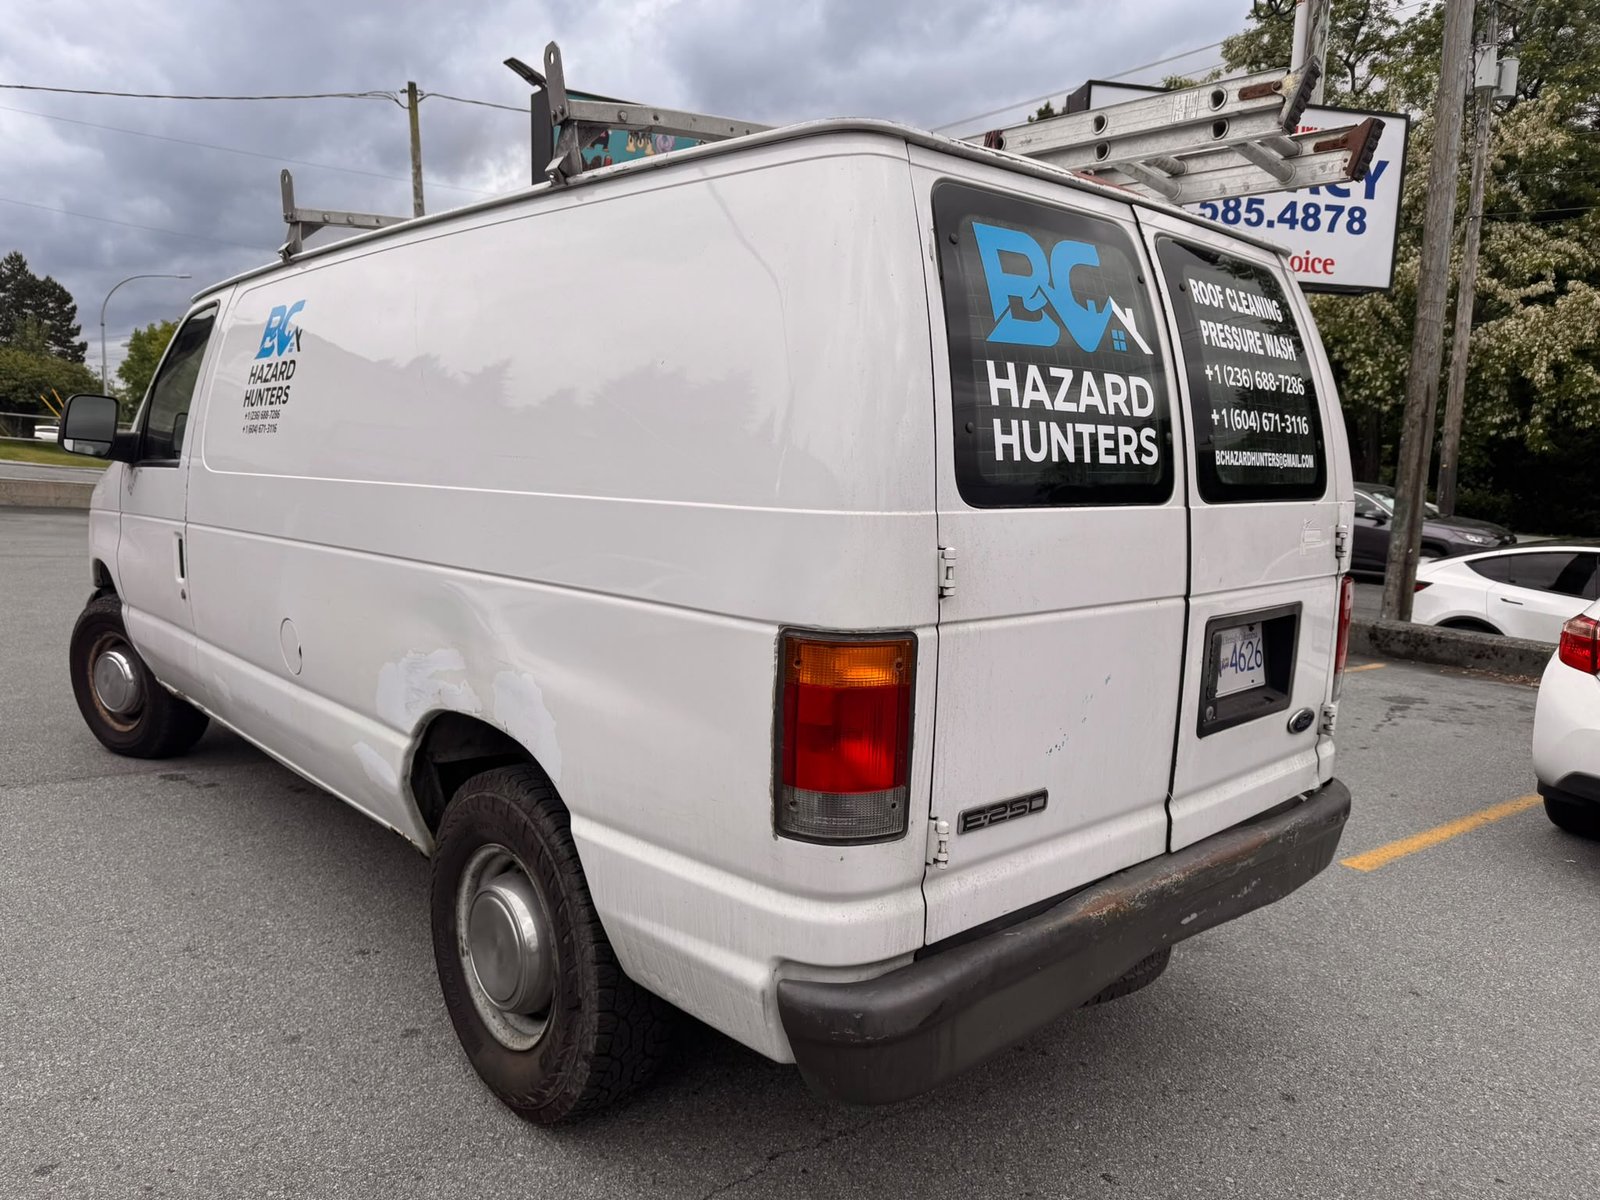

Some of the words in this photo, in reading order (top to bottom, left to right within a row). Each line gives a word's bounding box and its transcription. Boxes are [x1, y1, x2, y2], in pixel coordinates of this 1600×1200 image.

[972, 222, 1114, 353] BC
[1188, 278, 1225, 309] ROOF
[1225, 289, 1283, 323] CLEANING
[1199, 319, 1264, 355] PRESSURE
[1263, 333, 1297, 361] WASH
[248, 359, 296, 385] HAZARD
[986, 360, 1154, 418] HAZARD
[1223, 364, 1254, 391] (236)
[1254, 370, 1305, 396] 688-7286
[243, 385, 291, 408] HUNTERS
[1230, 408, 1260, 433] (604)
[1261, 412, 1309, 436] 671-3116
[993, 418, 1159, 466] HUNTERS
[1215, 449, 1314, 469] BCHAZARDHUNTERS@GMAIL.COM
[1230, 637, 1263, 674] 4626
